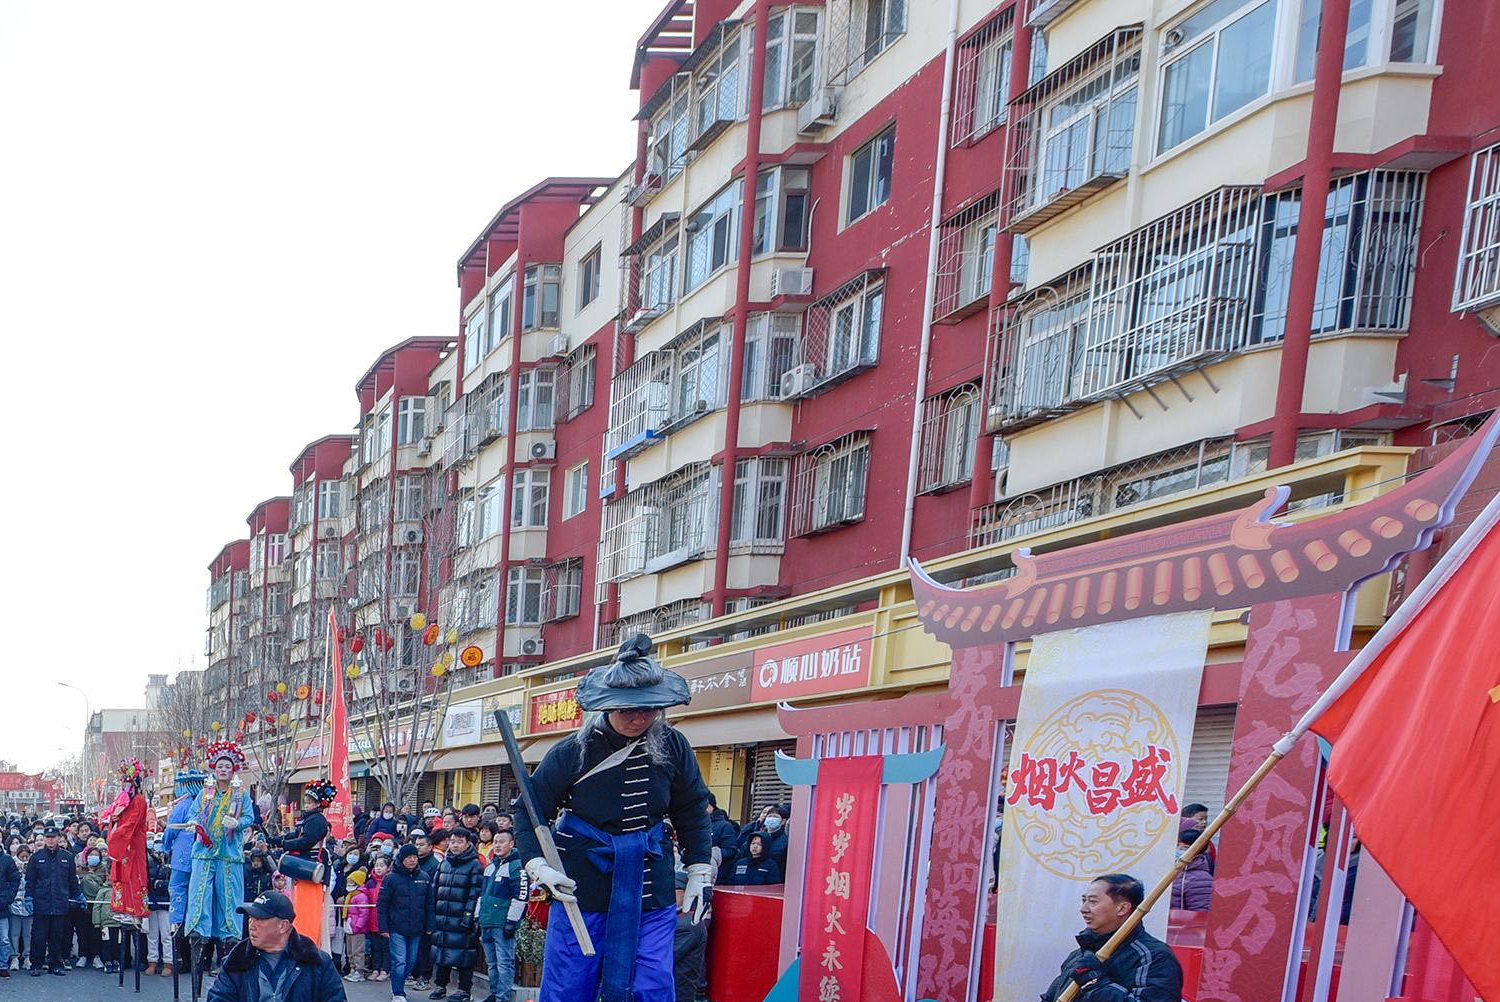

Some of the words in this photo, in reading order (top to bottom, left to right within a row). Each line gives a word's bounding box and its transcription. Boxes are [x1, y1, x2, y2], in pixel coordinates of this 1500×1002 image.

[780, 643, 863, 685] 顺心奶站
[1006, 745, 1179, 816] 烟火昌盛
[519, 868, 529, 901] MASTER
